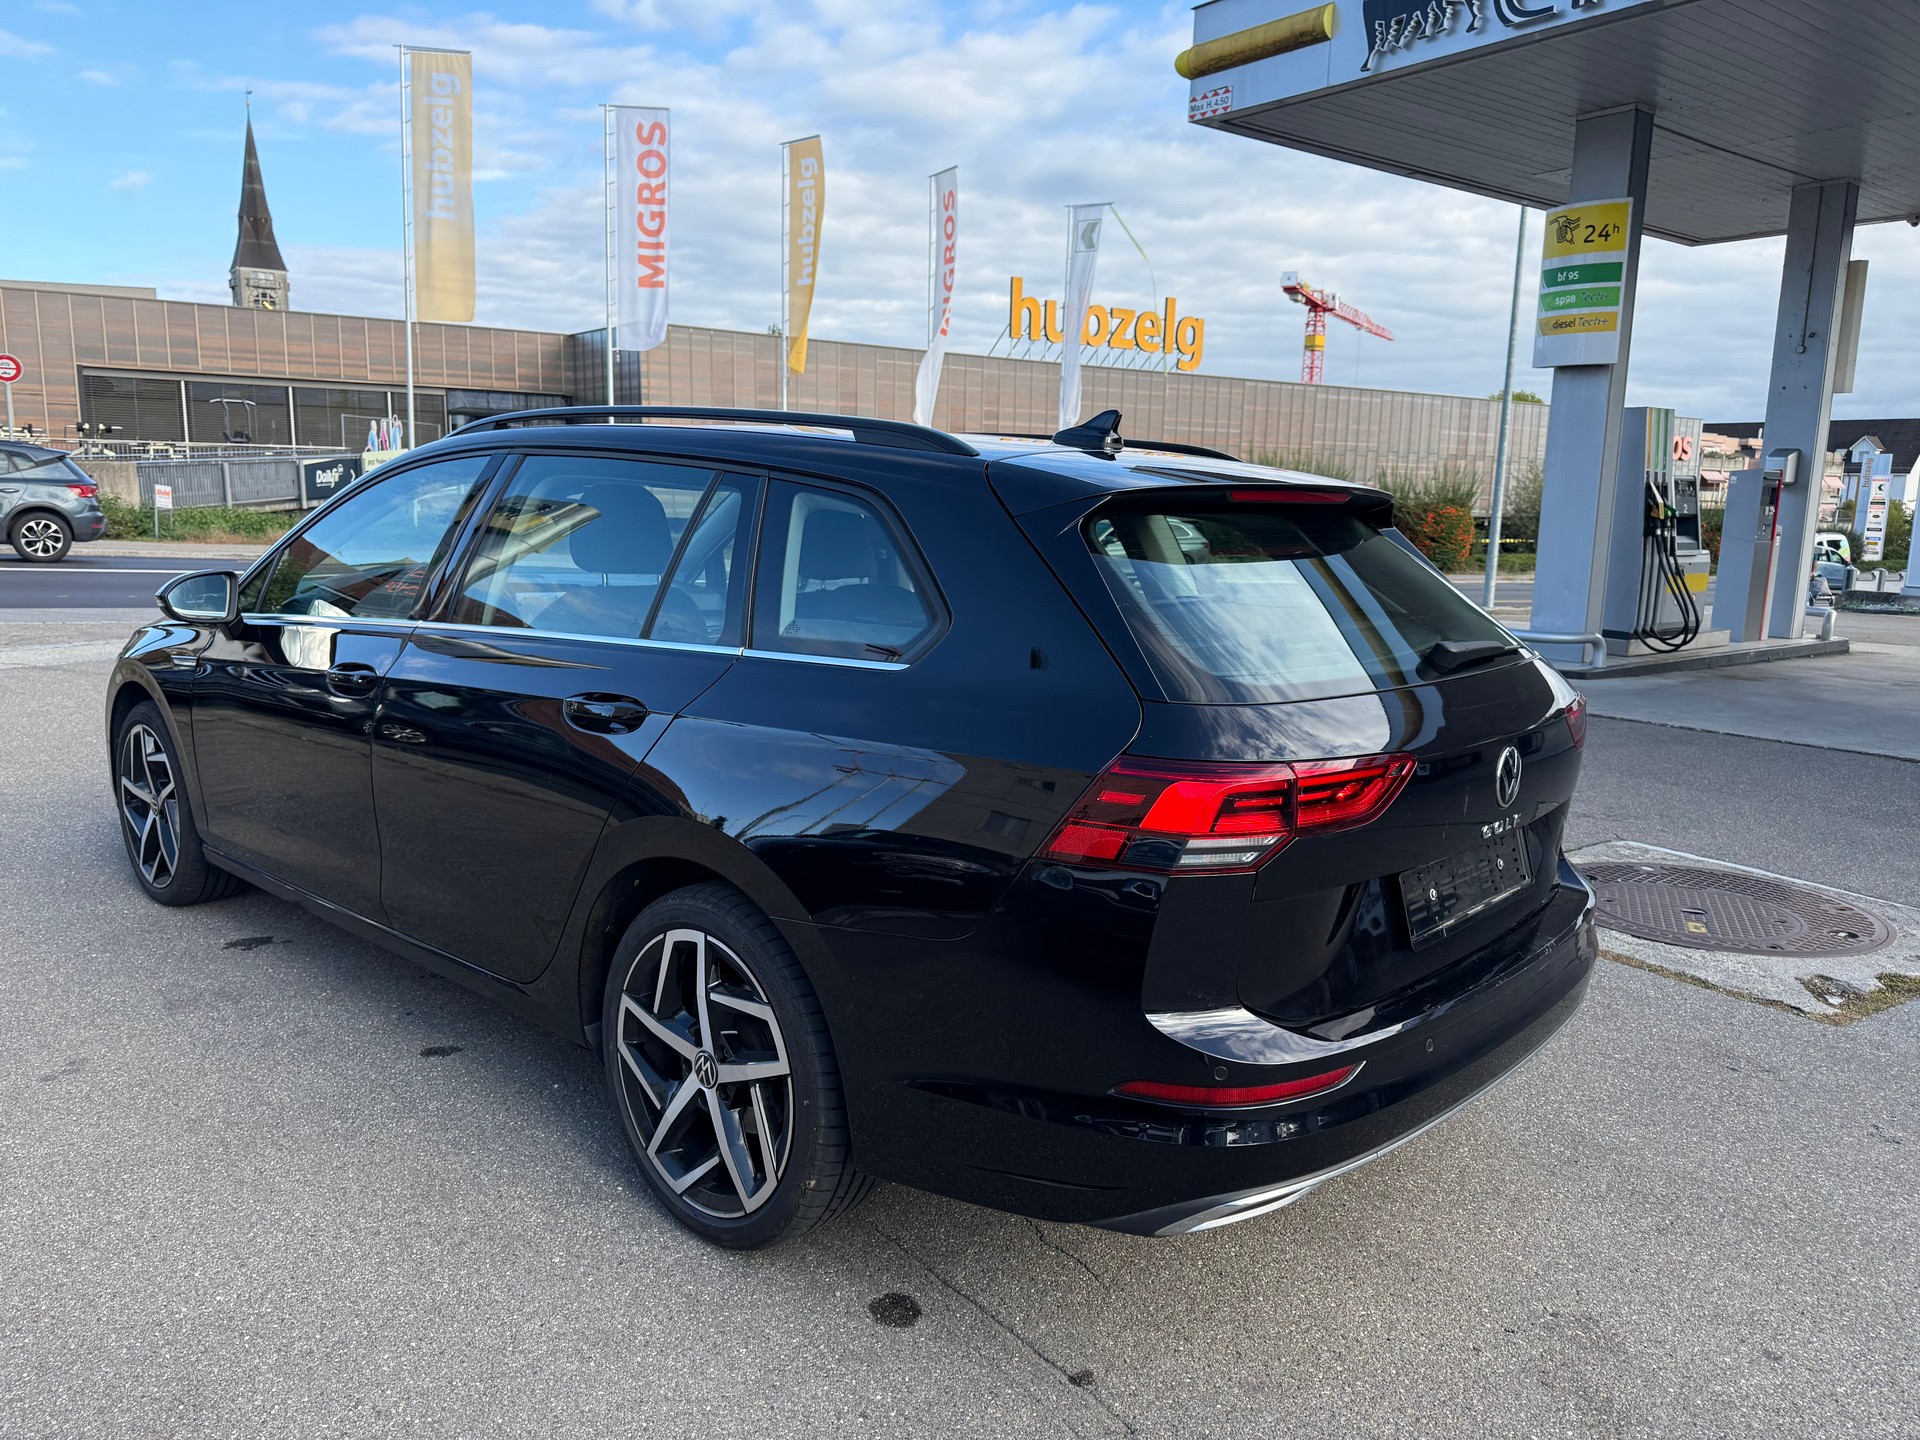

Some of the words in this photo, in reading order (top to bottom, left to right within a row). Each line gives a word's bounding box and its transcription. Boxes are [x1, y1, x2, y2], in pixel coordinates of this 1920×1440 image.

[423, 73, 461, 220] hubzelg
[636, 120, 667, 289] MIGROS
[797, 157, 819, 286] hubzelg
[1557, 271, 1567, 282] bf
[1567, 271, 1579, 281] 95
[1555, 294, 1576, 306] sp98
[1580, 291, 1612, 302] Tech+
[1552, 318, 1576, 330] diesel
[1577, 317, 1608, 327] Tech+
[1861, 457, 1874, 488] hubzelg
[1683, 503, 1688, 514] 2
[1480, 813, 1522, 839] GOLF
